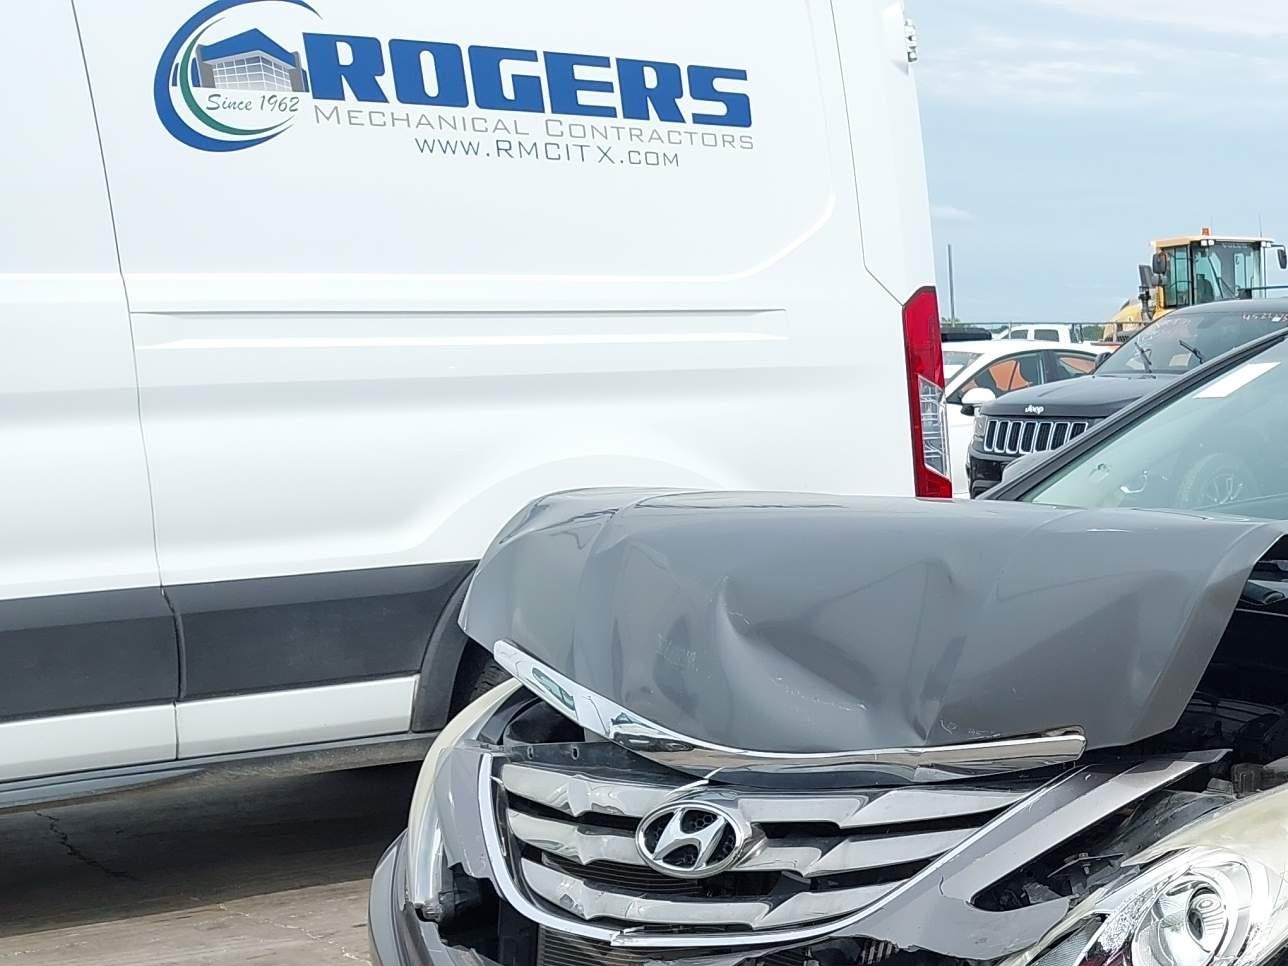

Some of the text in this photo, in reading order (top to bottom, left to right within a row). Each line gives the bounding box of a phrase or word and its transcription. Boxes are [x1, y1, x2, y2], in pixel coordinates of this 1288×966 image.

[303, 32, 752, 128] ROGERS
[206, 93, 300, 113] Since 1962
[1024, 404, 1045, 416] Jeep
